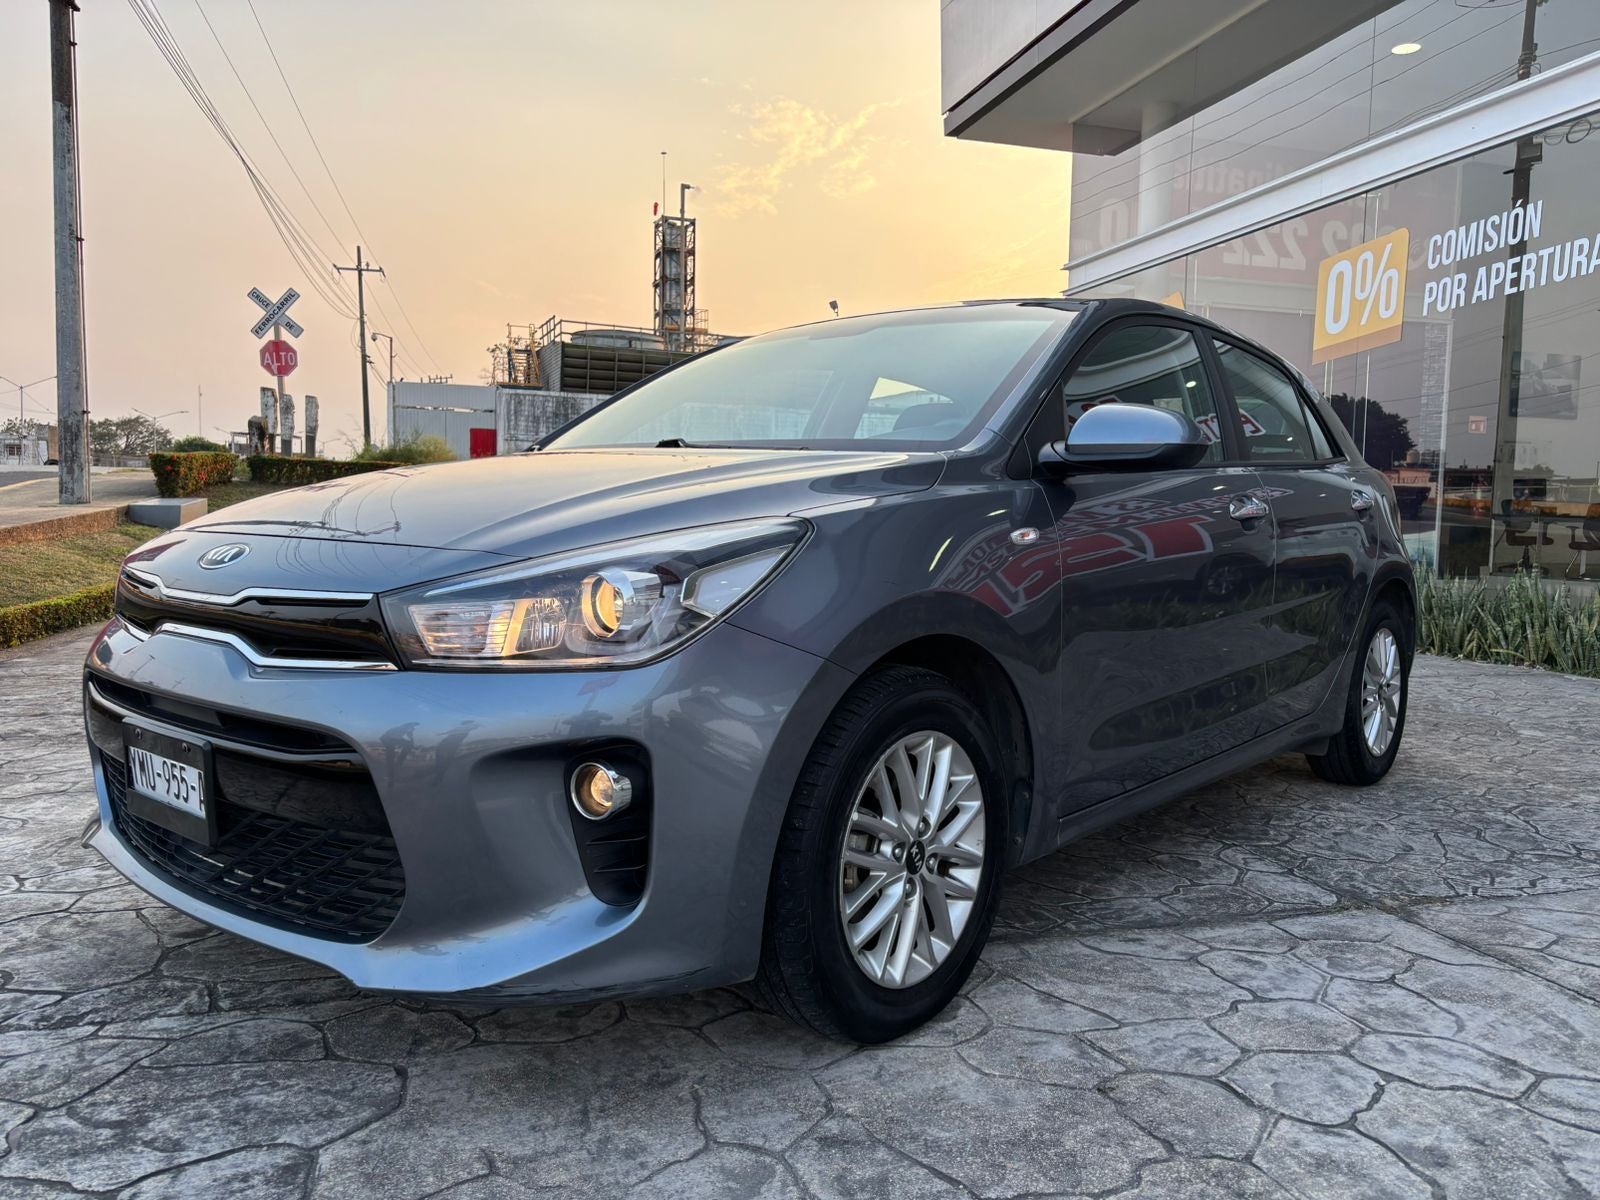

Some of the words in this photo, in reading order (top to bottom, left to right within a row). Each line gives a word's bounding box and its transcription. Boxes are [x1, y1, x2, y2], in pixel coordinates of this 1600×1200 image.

[1427, 198, 1543, 270] COMISIÓN
[1325, 243, 1399, 335] 0%
[1422, 272, 1468, 317] POR
[251, 291, 271, 309] CRUCE
[284, 321, 295, 331] DE
[254, 292, 296, 335] FERROCARRIL
[263, 351, 296, 367] ALTO
[205, 545, 240, 562] KIA
[910, 844, 923, 872] KIA
